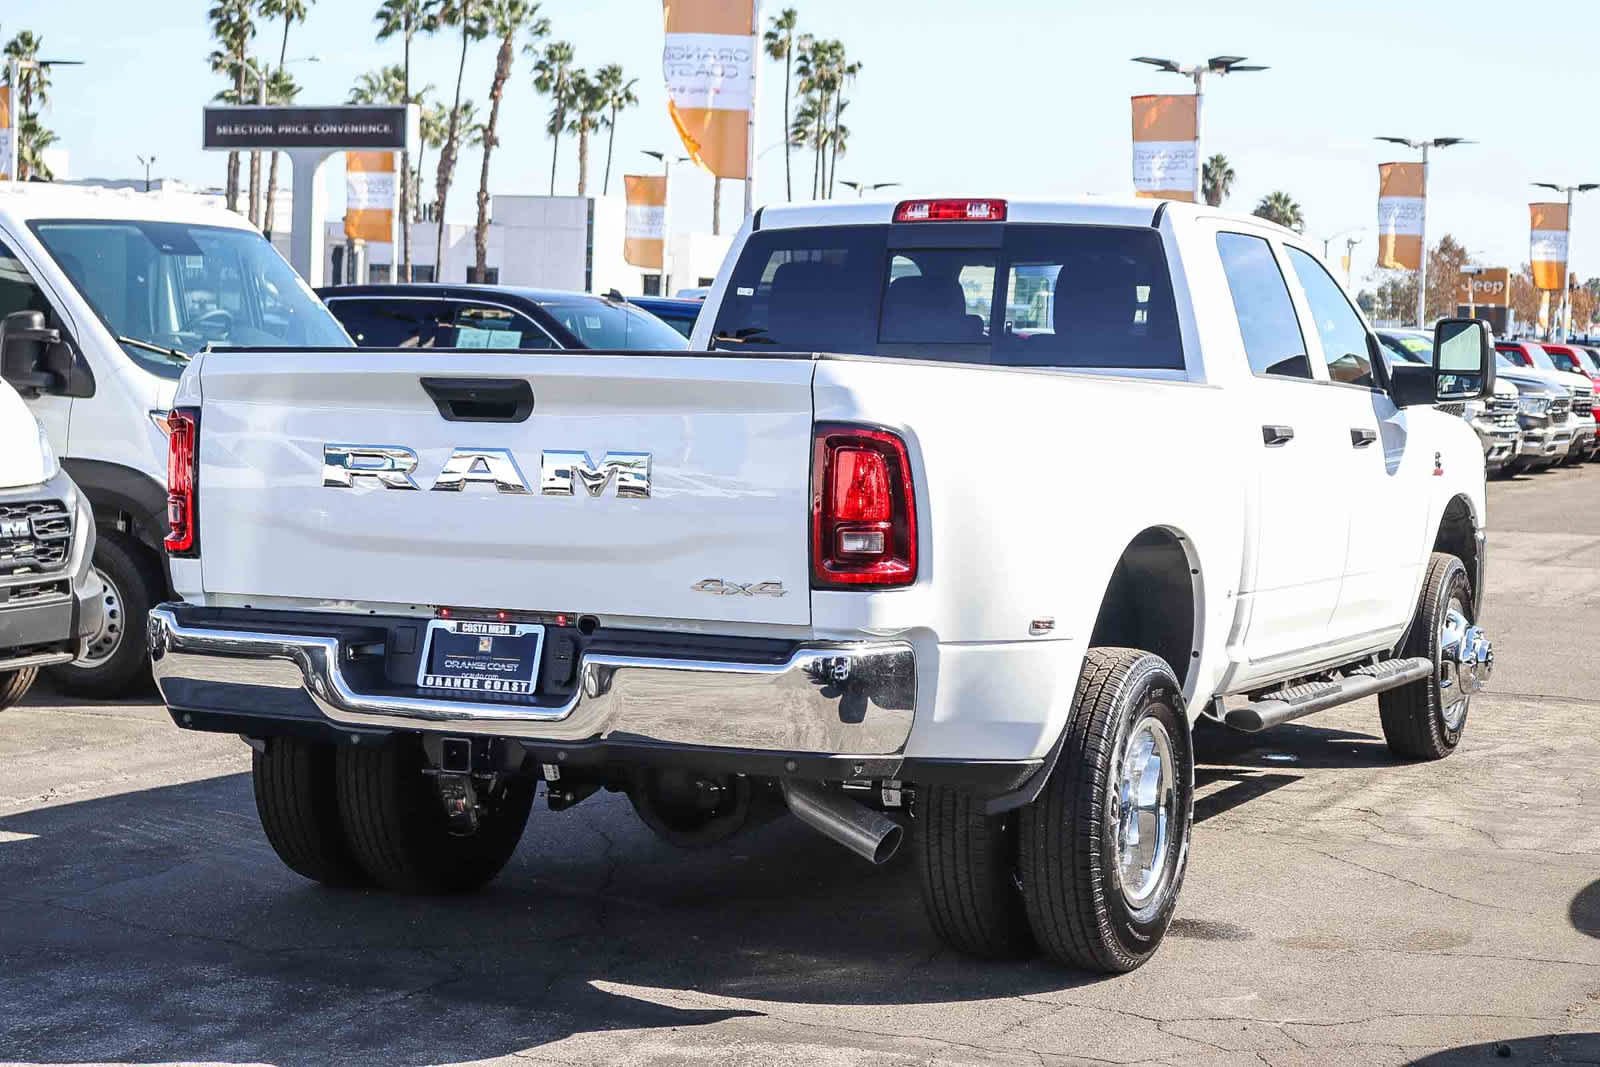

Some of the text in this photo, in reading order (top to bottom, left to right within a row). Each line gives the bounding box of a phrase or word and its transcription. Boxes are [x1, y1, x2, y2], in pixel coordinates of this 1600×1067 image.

[216, 123, 393, 136] SELECTION. PRICE. CONVENIENCE.
[1461, 278, 1504, 295] Jeep
[322, 443, 652, 499] RAM
[690, 578, 789, 598] 4x4
[462, 623, 511, 634] COSTA MESA
[444, 660, 519, 672] ORANGE COAST
[425, 676, 528, 693] ORANGE COAST
